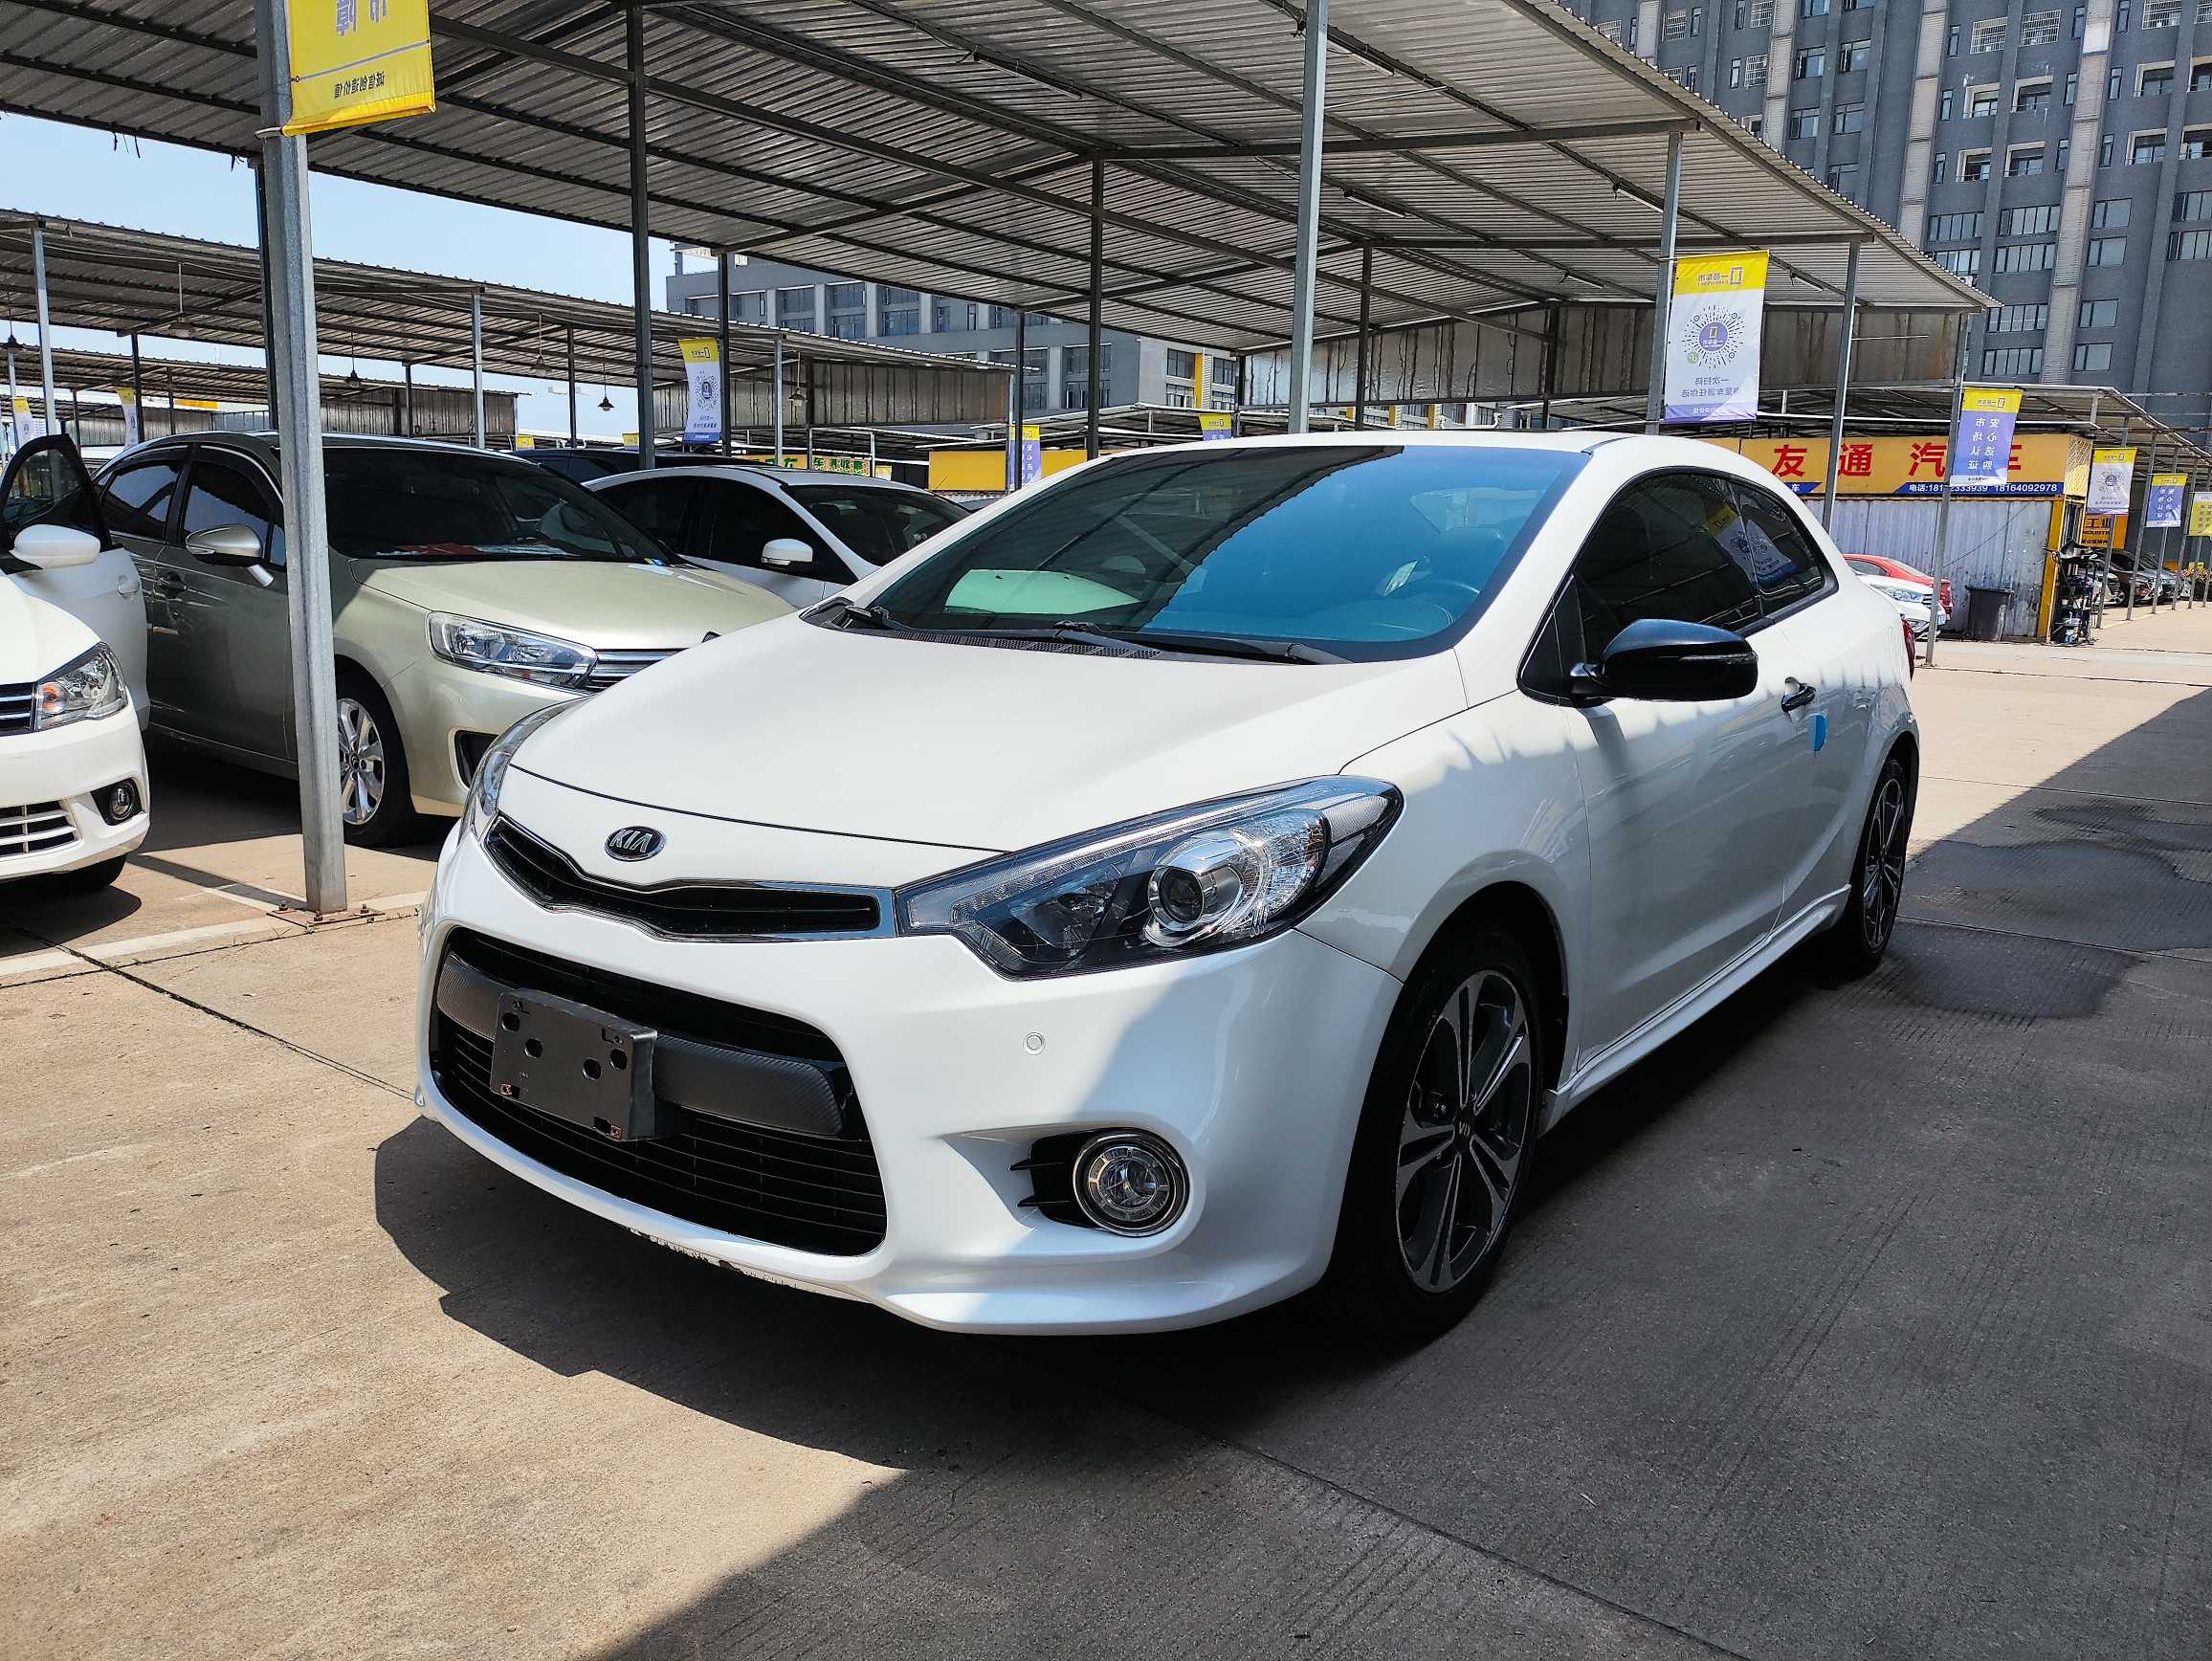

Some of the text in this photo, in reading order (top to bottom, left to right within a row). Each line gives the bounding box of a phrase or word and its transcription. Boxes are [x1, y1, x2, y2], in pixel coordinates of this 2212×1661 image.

[1909, 483, 2058, 493] 电话:1812333939 18164092978
[609, 829, 653, 853] KIA
